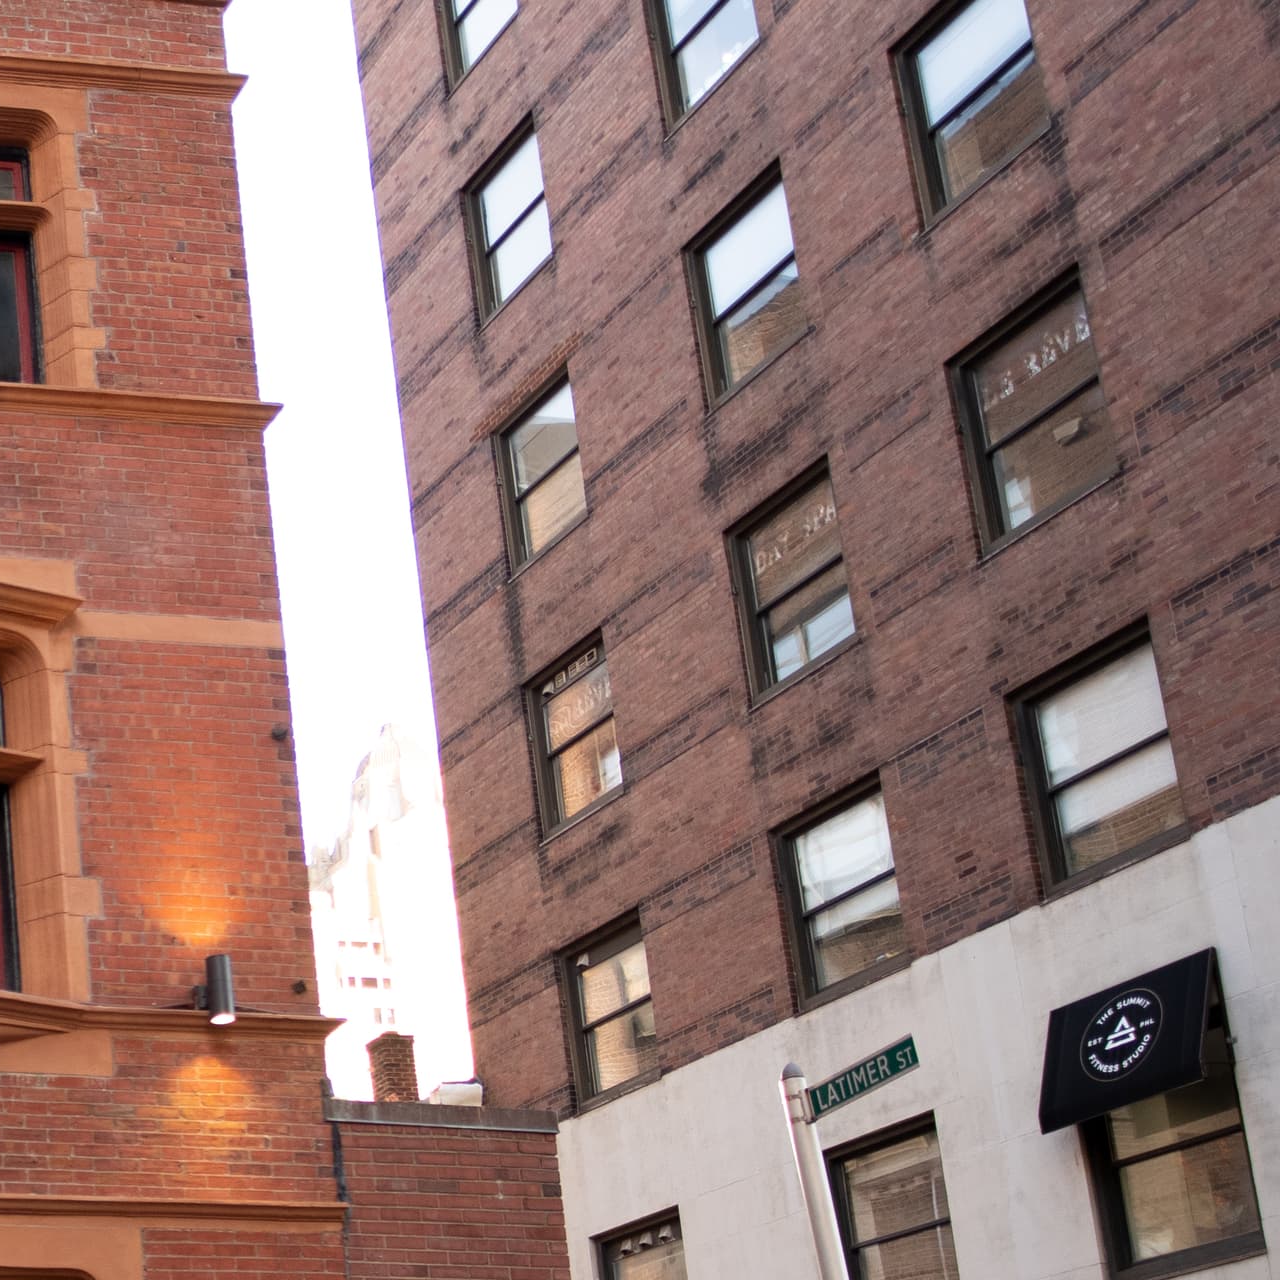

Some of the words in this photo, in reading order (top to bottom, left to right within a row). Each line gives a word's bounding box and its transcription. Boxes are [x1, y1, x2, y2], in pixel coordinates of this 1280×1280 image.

[1096, 1008, 1114, 1025] THE
[1116, 996, 1151, 1010] SUMMIT
[1087, 1037, 1103, 1047] EST
[1088, 1054, 1119, 1073] FITNESS
[1122, 1034, 1151, 1069] STUDIO
[815, 1055, 891, 1110] LATIMER
[895, 1046, 913, 1069] ST
